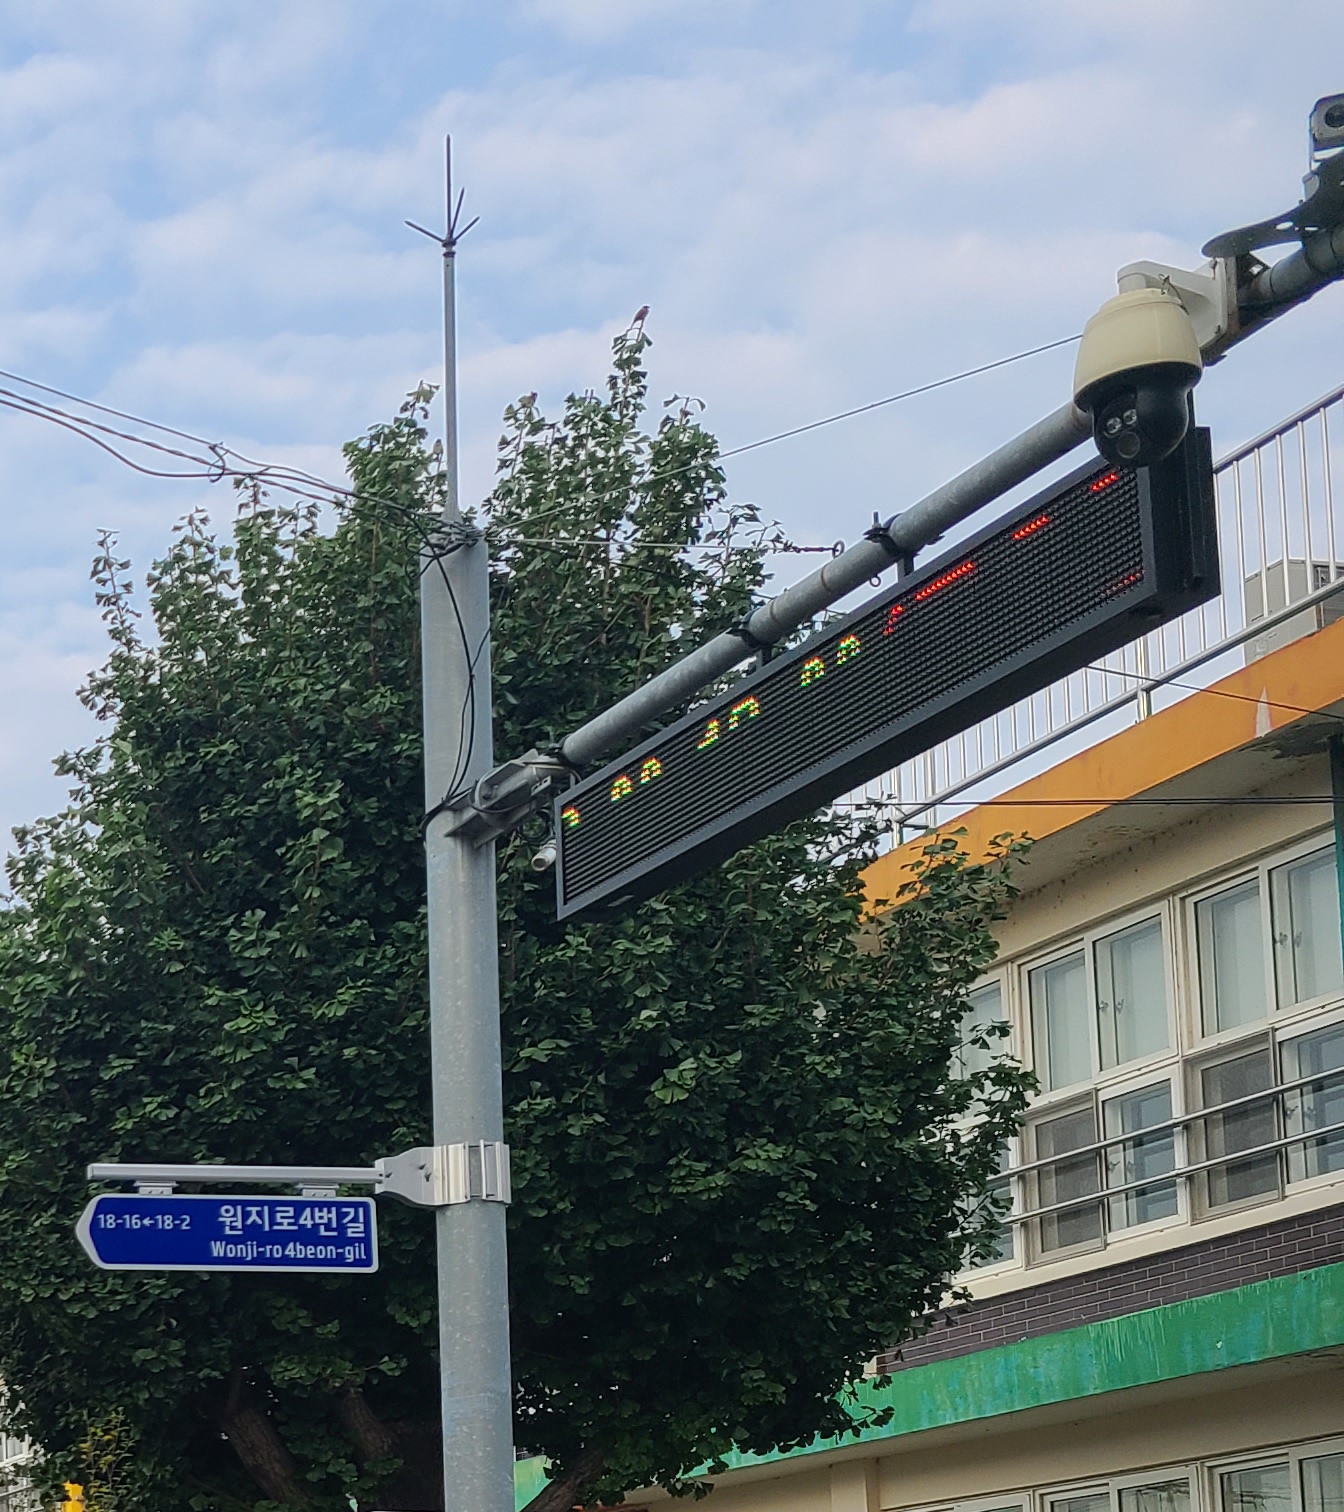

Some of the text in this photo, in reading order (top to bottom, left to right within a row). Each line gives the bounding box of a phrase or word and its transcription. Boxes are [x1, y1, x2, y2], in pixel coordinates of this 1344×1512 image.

[97, 1213, 141, 1229] 18-16
[217, 1204, 365, 1237] 원지로4번길
[211, 1240, 367, 1262] Wonji-ro 4beon-gil
